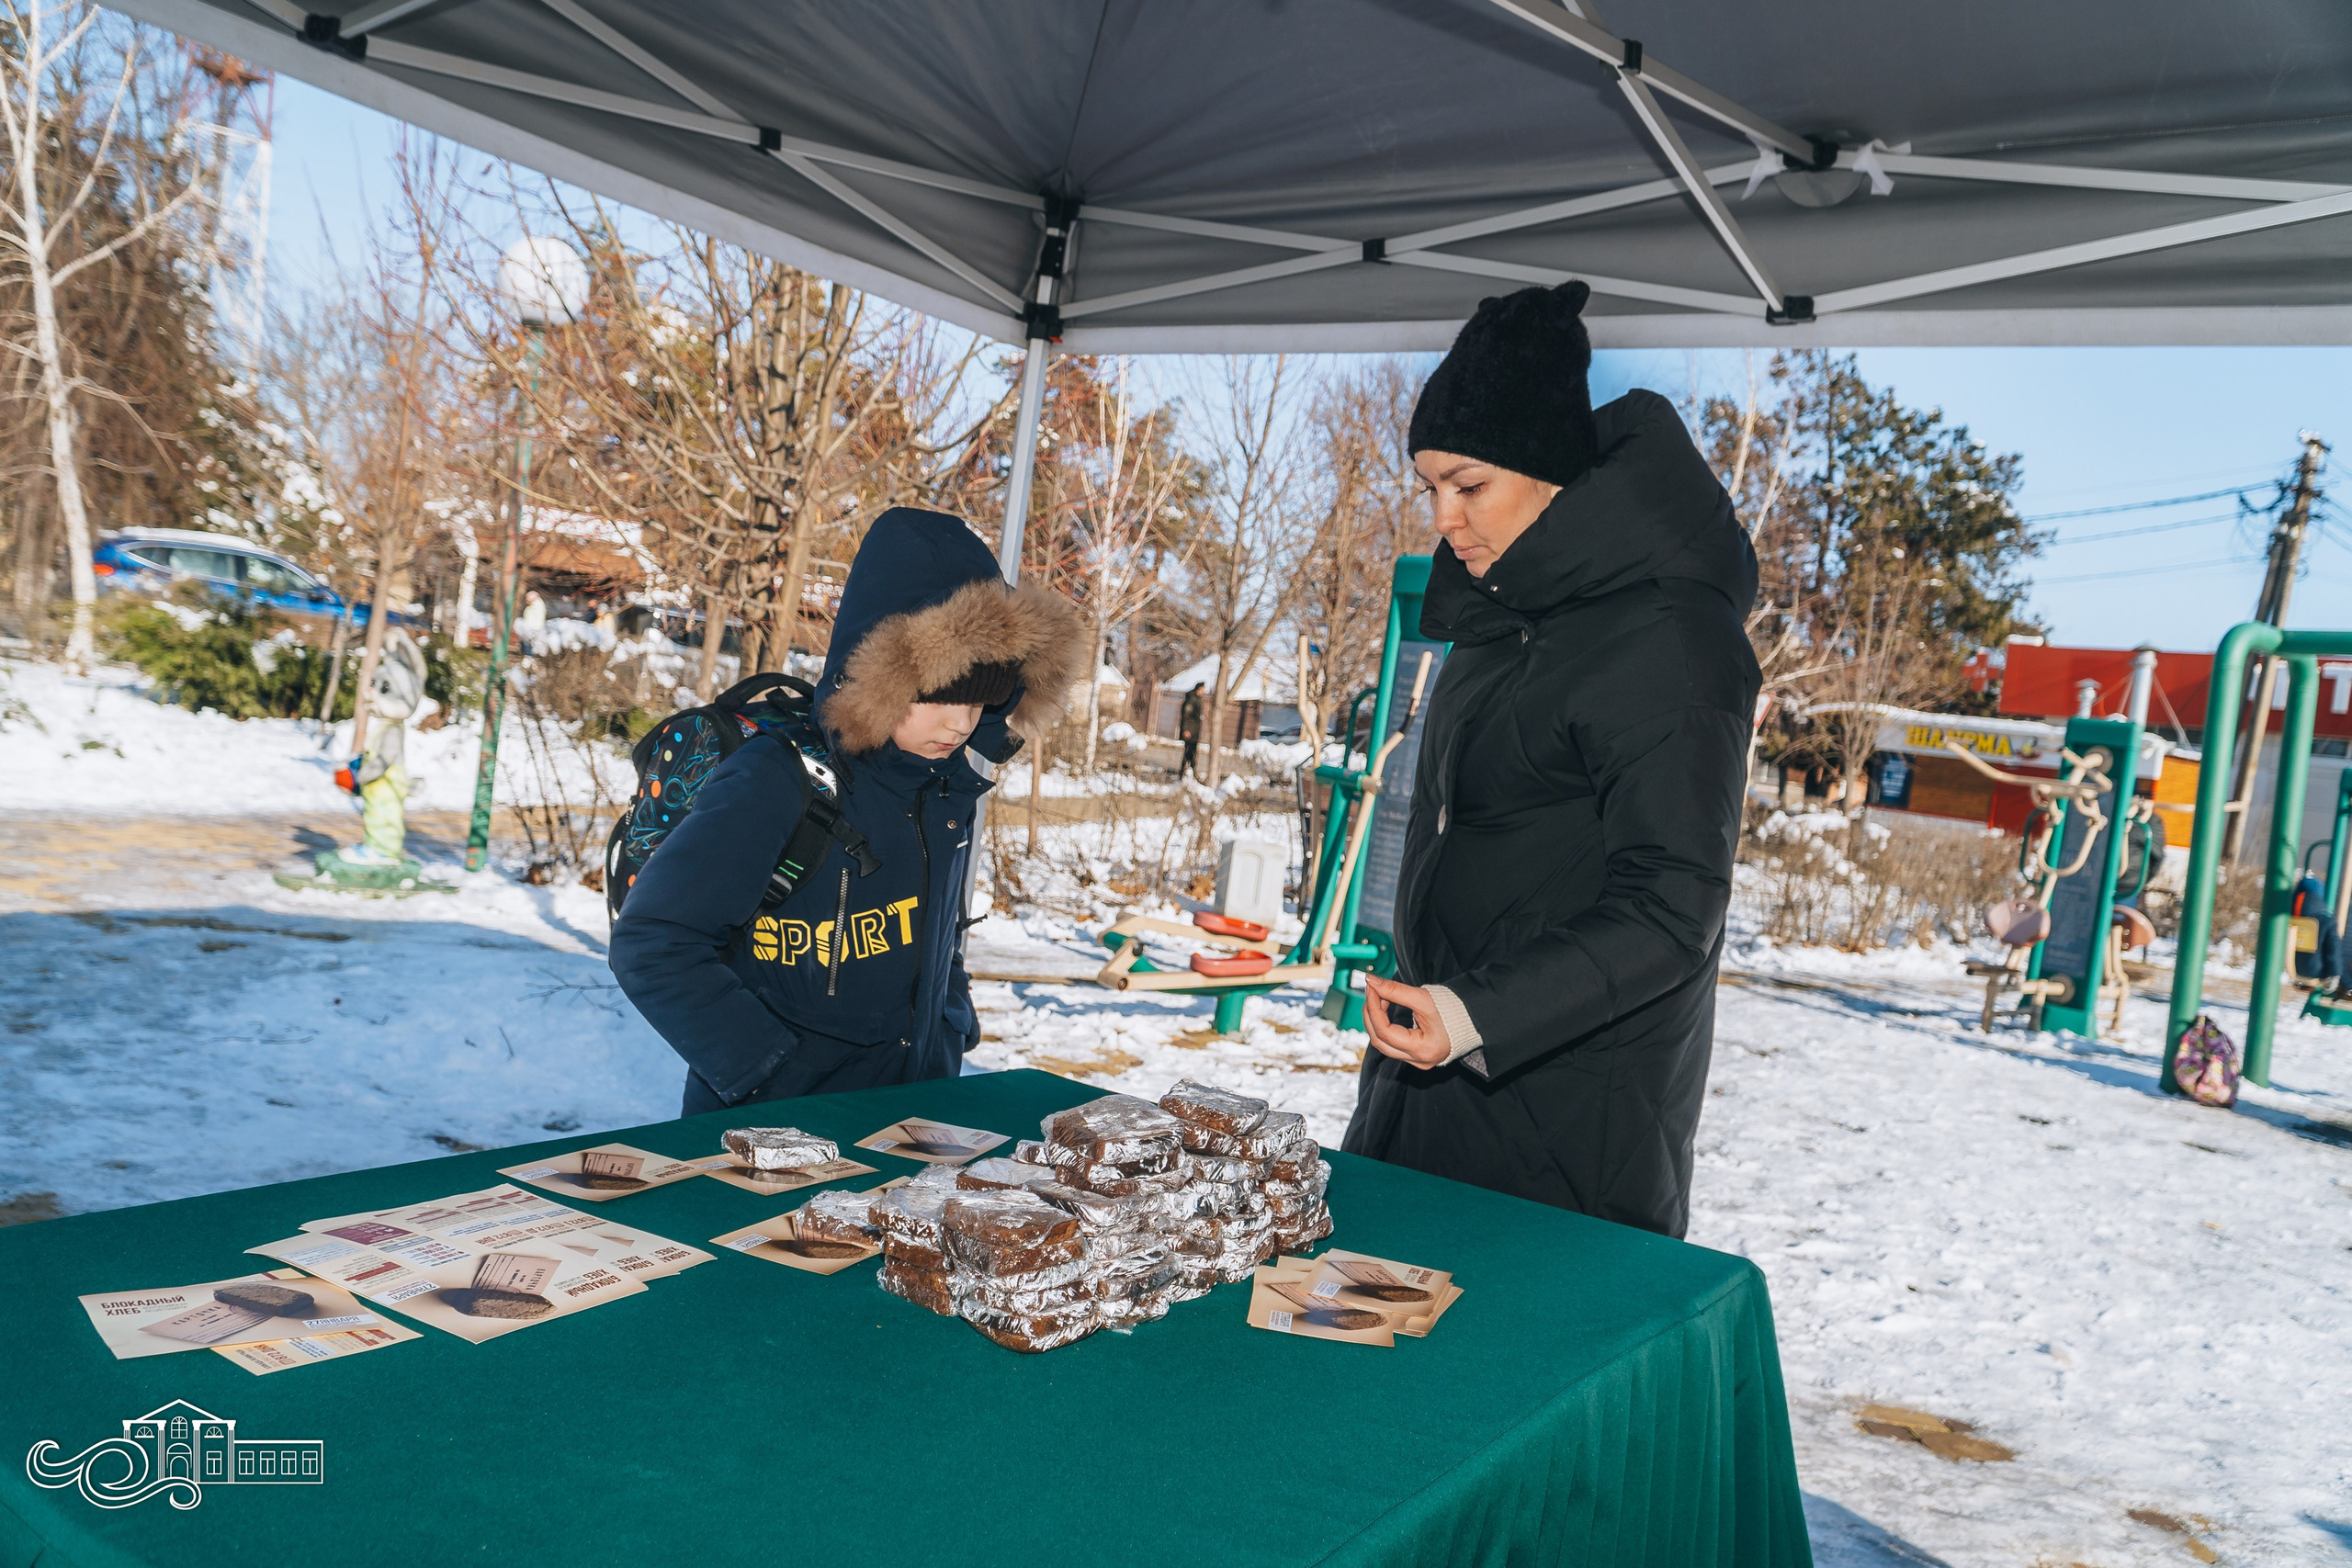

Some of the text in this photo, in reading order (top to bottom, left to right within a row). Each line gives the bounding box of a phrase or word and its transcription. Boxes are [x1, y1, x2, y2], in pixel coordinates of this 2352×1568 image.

[752, 896, 919, 967] SPORT
[100, 1295, 186, 1310] БЛОКАДНЫЙ
[105, 1306, 141, 1317] ХЛЕБ
